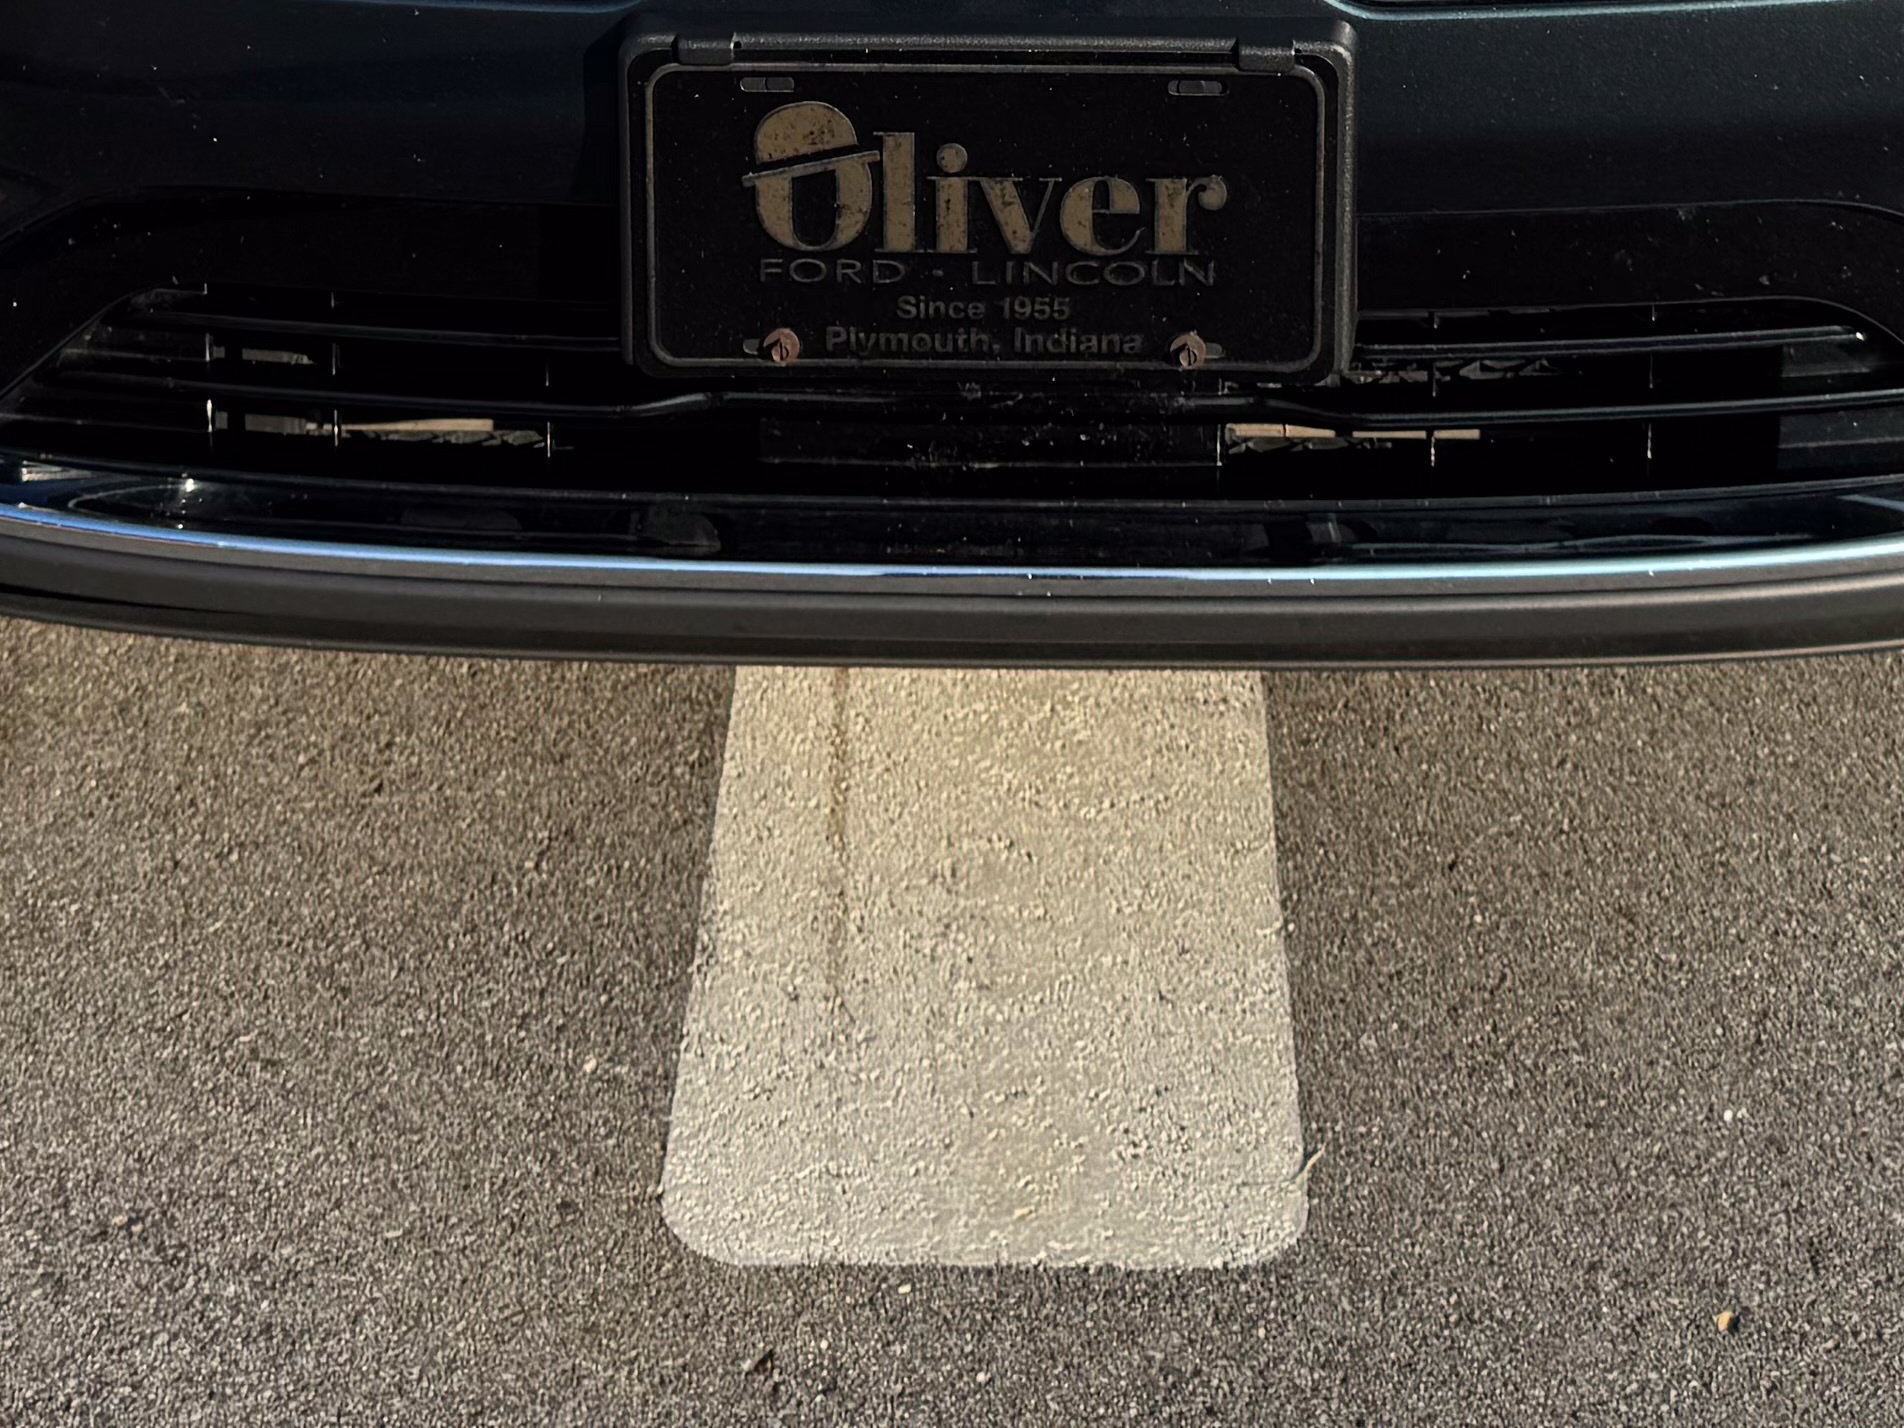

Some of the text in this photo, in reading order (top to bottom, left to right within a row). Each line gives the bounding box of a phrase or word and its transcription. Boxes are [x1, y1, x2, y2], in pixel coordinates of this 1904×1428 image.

[742, 101, 1228, 255] Oliver
[759, 258, 906, 284] FORD
[972, 259, 1216, 286] LINCOLN
[896, 295, 1072, 320] Since 1955
[825, 325, 1144, 356] Plymouth, Indiana
